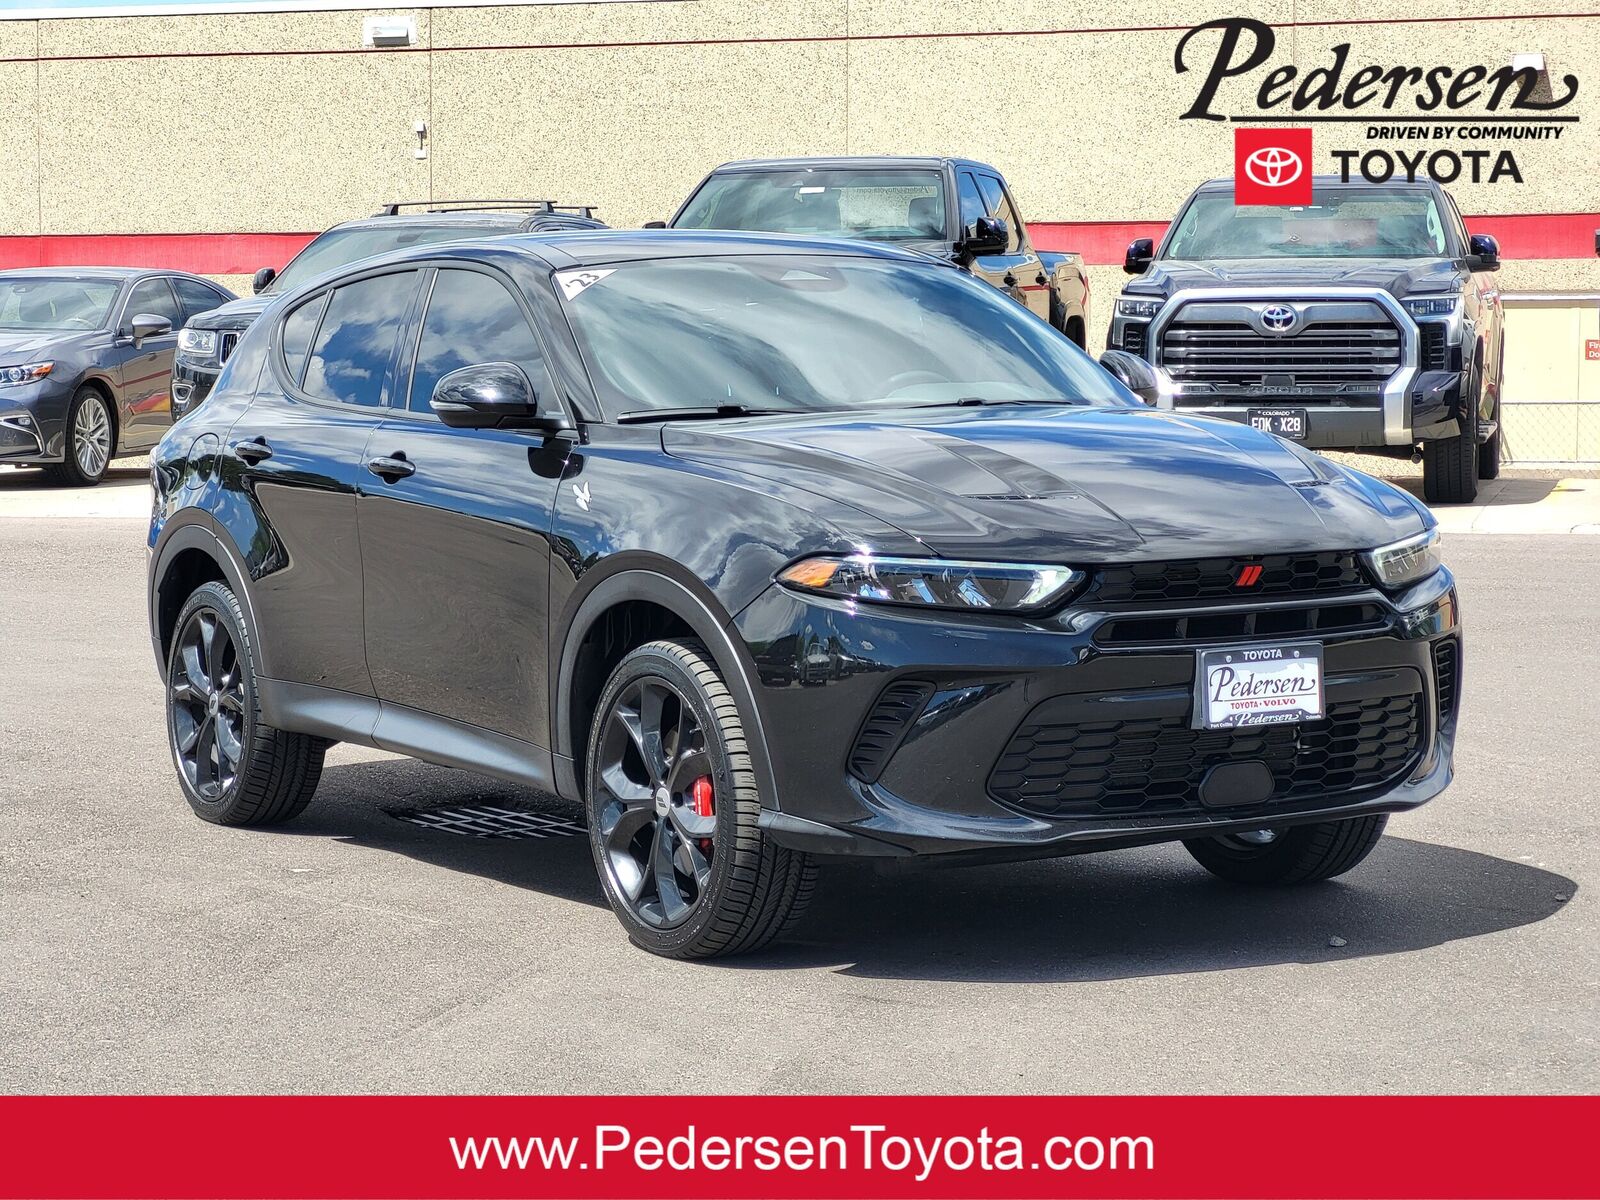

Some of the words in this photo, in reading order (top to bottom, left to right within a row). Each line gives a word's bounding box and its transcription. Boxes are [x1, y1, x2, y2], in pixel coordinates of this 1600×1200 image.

[1243, 649, 1283, 660] TOYOTA
[1210, 666, 1316, 702] Pedersen
[1231, 701, 1258, 710] TOYOTA
[1264, 698, 1296, 707] VOLVO
[1235, 712, 1299, 727] Pedersen
